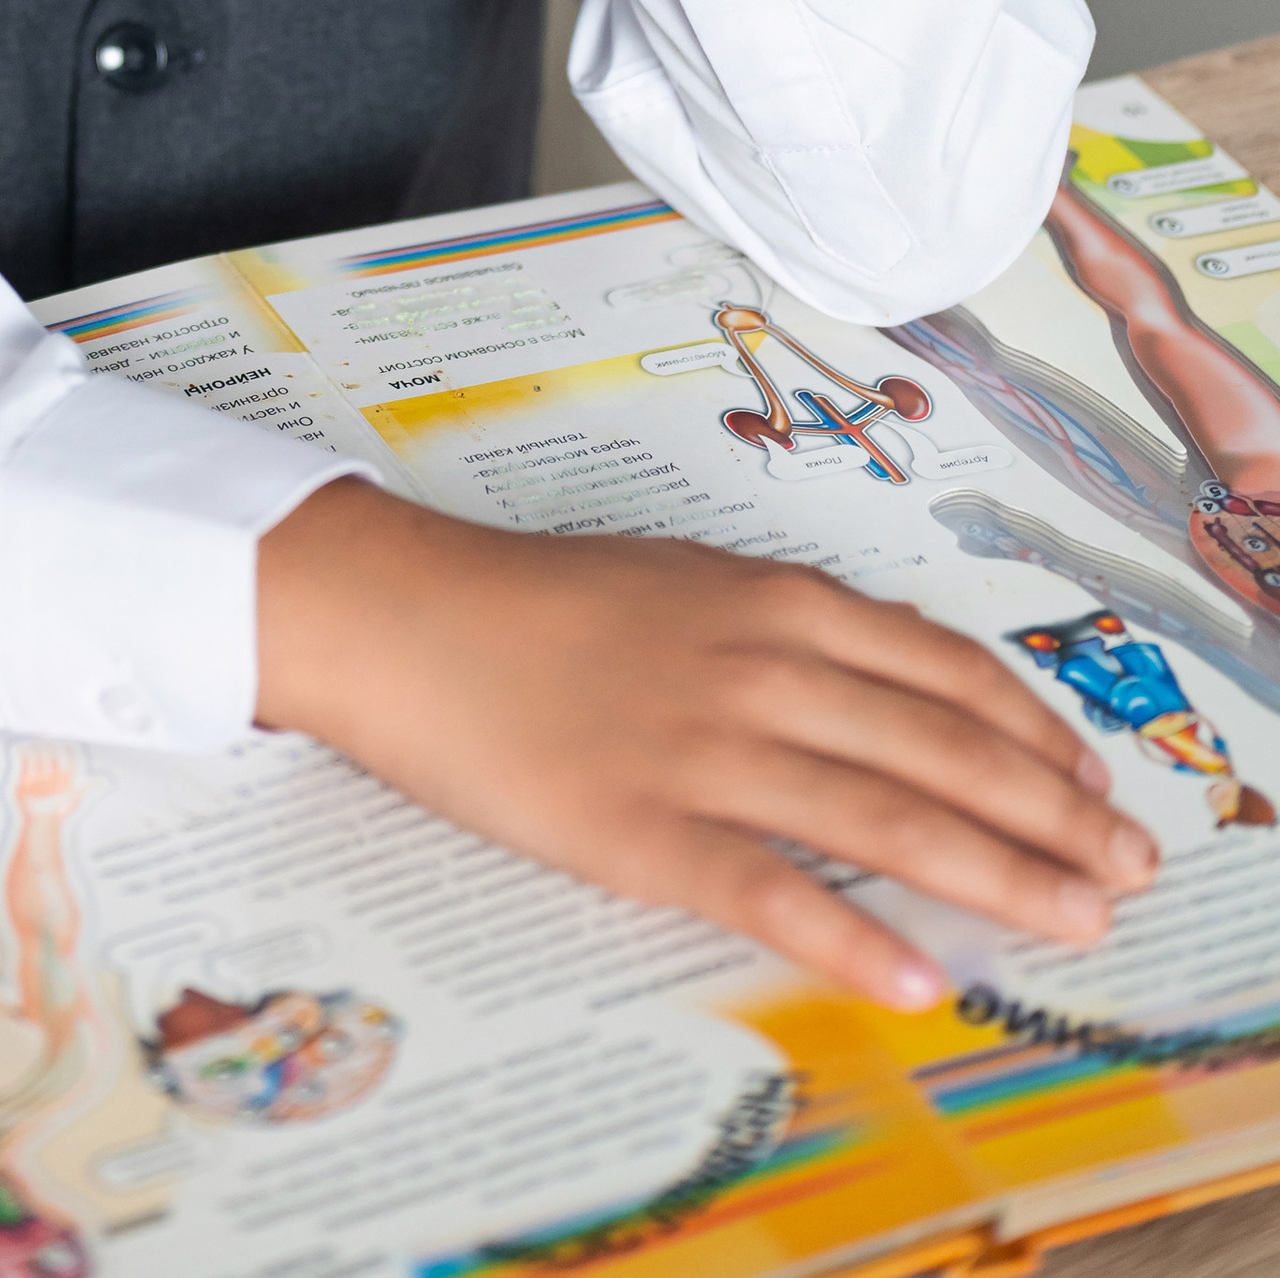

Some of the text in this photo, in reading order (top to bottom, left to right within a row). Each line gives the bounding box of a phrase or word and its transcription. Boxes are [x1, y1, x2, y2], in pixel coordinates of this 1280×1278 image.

[152, 316, 230, 343] отросток
[228, 330, 241, 340] и
[148, 333, 226, 361] отростки
[243, 345, 254, 355] У
[444, 339, 526, 361] основном
[167, 349, 238, 373] каждого
[377, 355, 443, 374] состоит
[183, 368, 272, 397] НЕЙРОНЫ
[388, 374, 441, 390] МОЧА
[288, 401, 301, 410] и
[276, 416, 314, 431] Они
[459, 432, 589, 465] тельный канал.
[590, 438, 641, 455] через
[621, 452, 653, 465] она
[805, 456, 843, 470] Почка
[939, 455, 989, 471] Артерия
[654, 521, 667, 530] в
